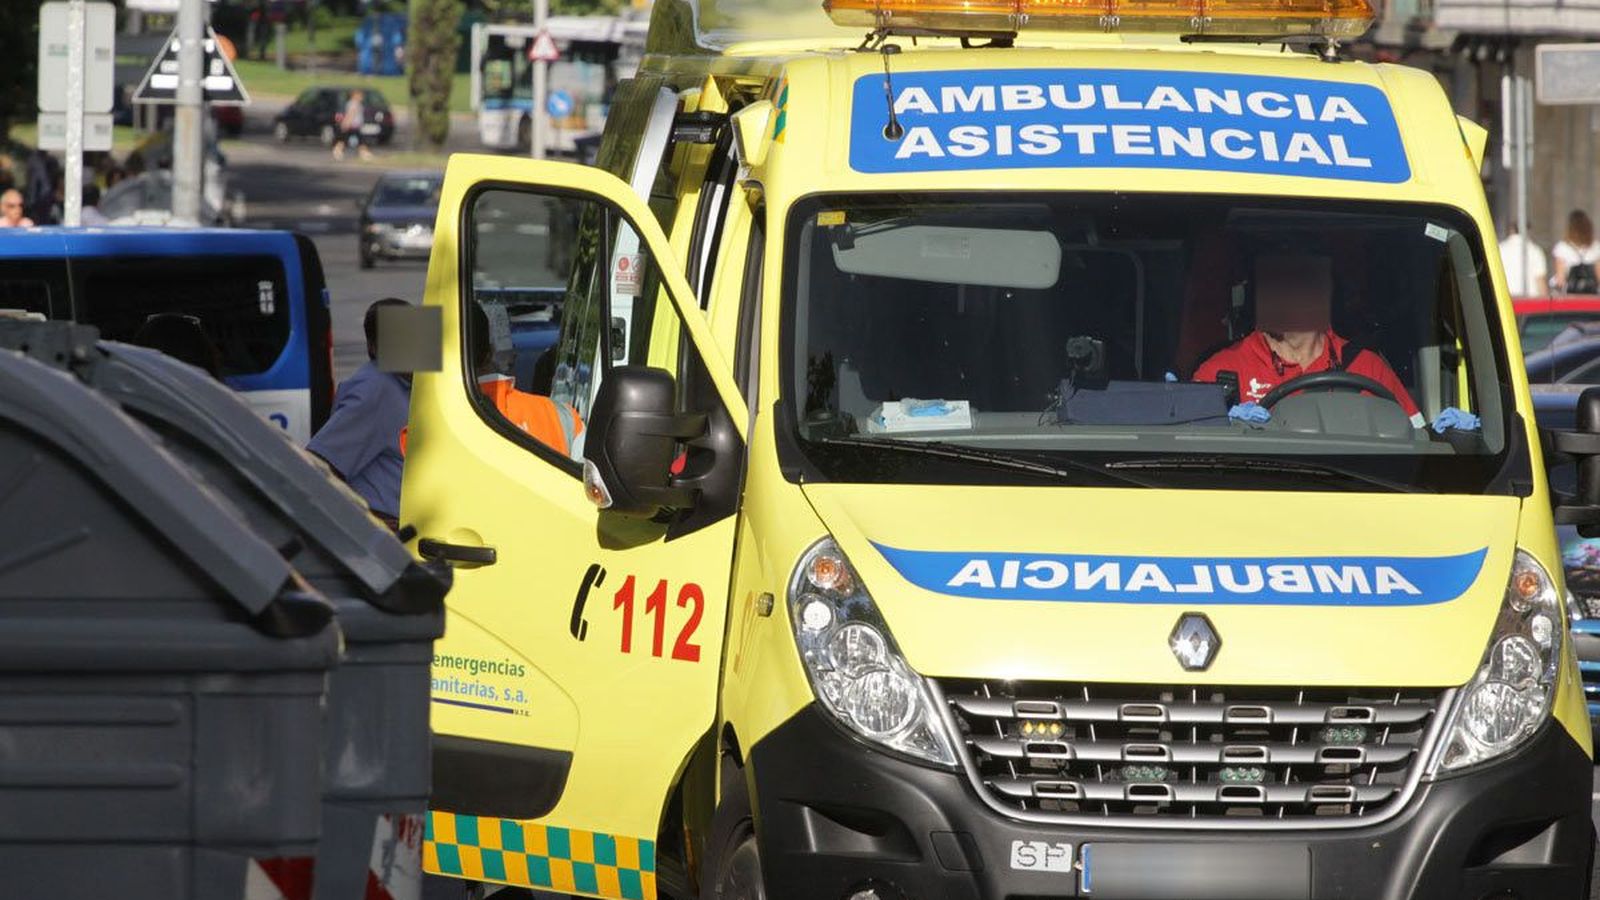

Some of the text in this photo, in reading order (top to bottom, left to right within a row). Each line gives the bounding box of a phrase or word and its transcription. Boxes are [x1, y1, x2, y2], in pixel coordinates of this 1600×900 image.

[889, 84, 1369, 125] AMBULANCIA
[894, 124, 1373, 168] ASISTENCIAL
[613, 574, 705, 663] 112
[431, 654, 525, 677] emergencias
[430, 675, 528, 704] anitarias, s.a.
[1016, 844, 1067, 868] SP
